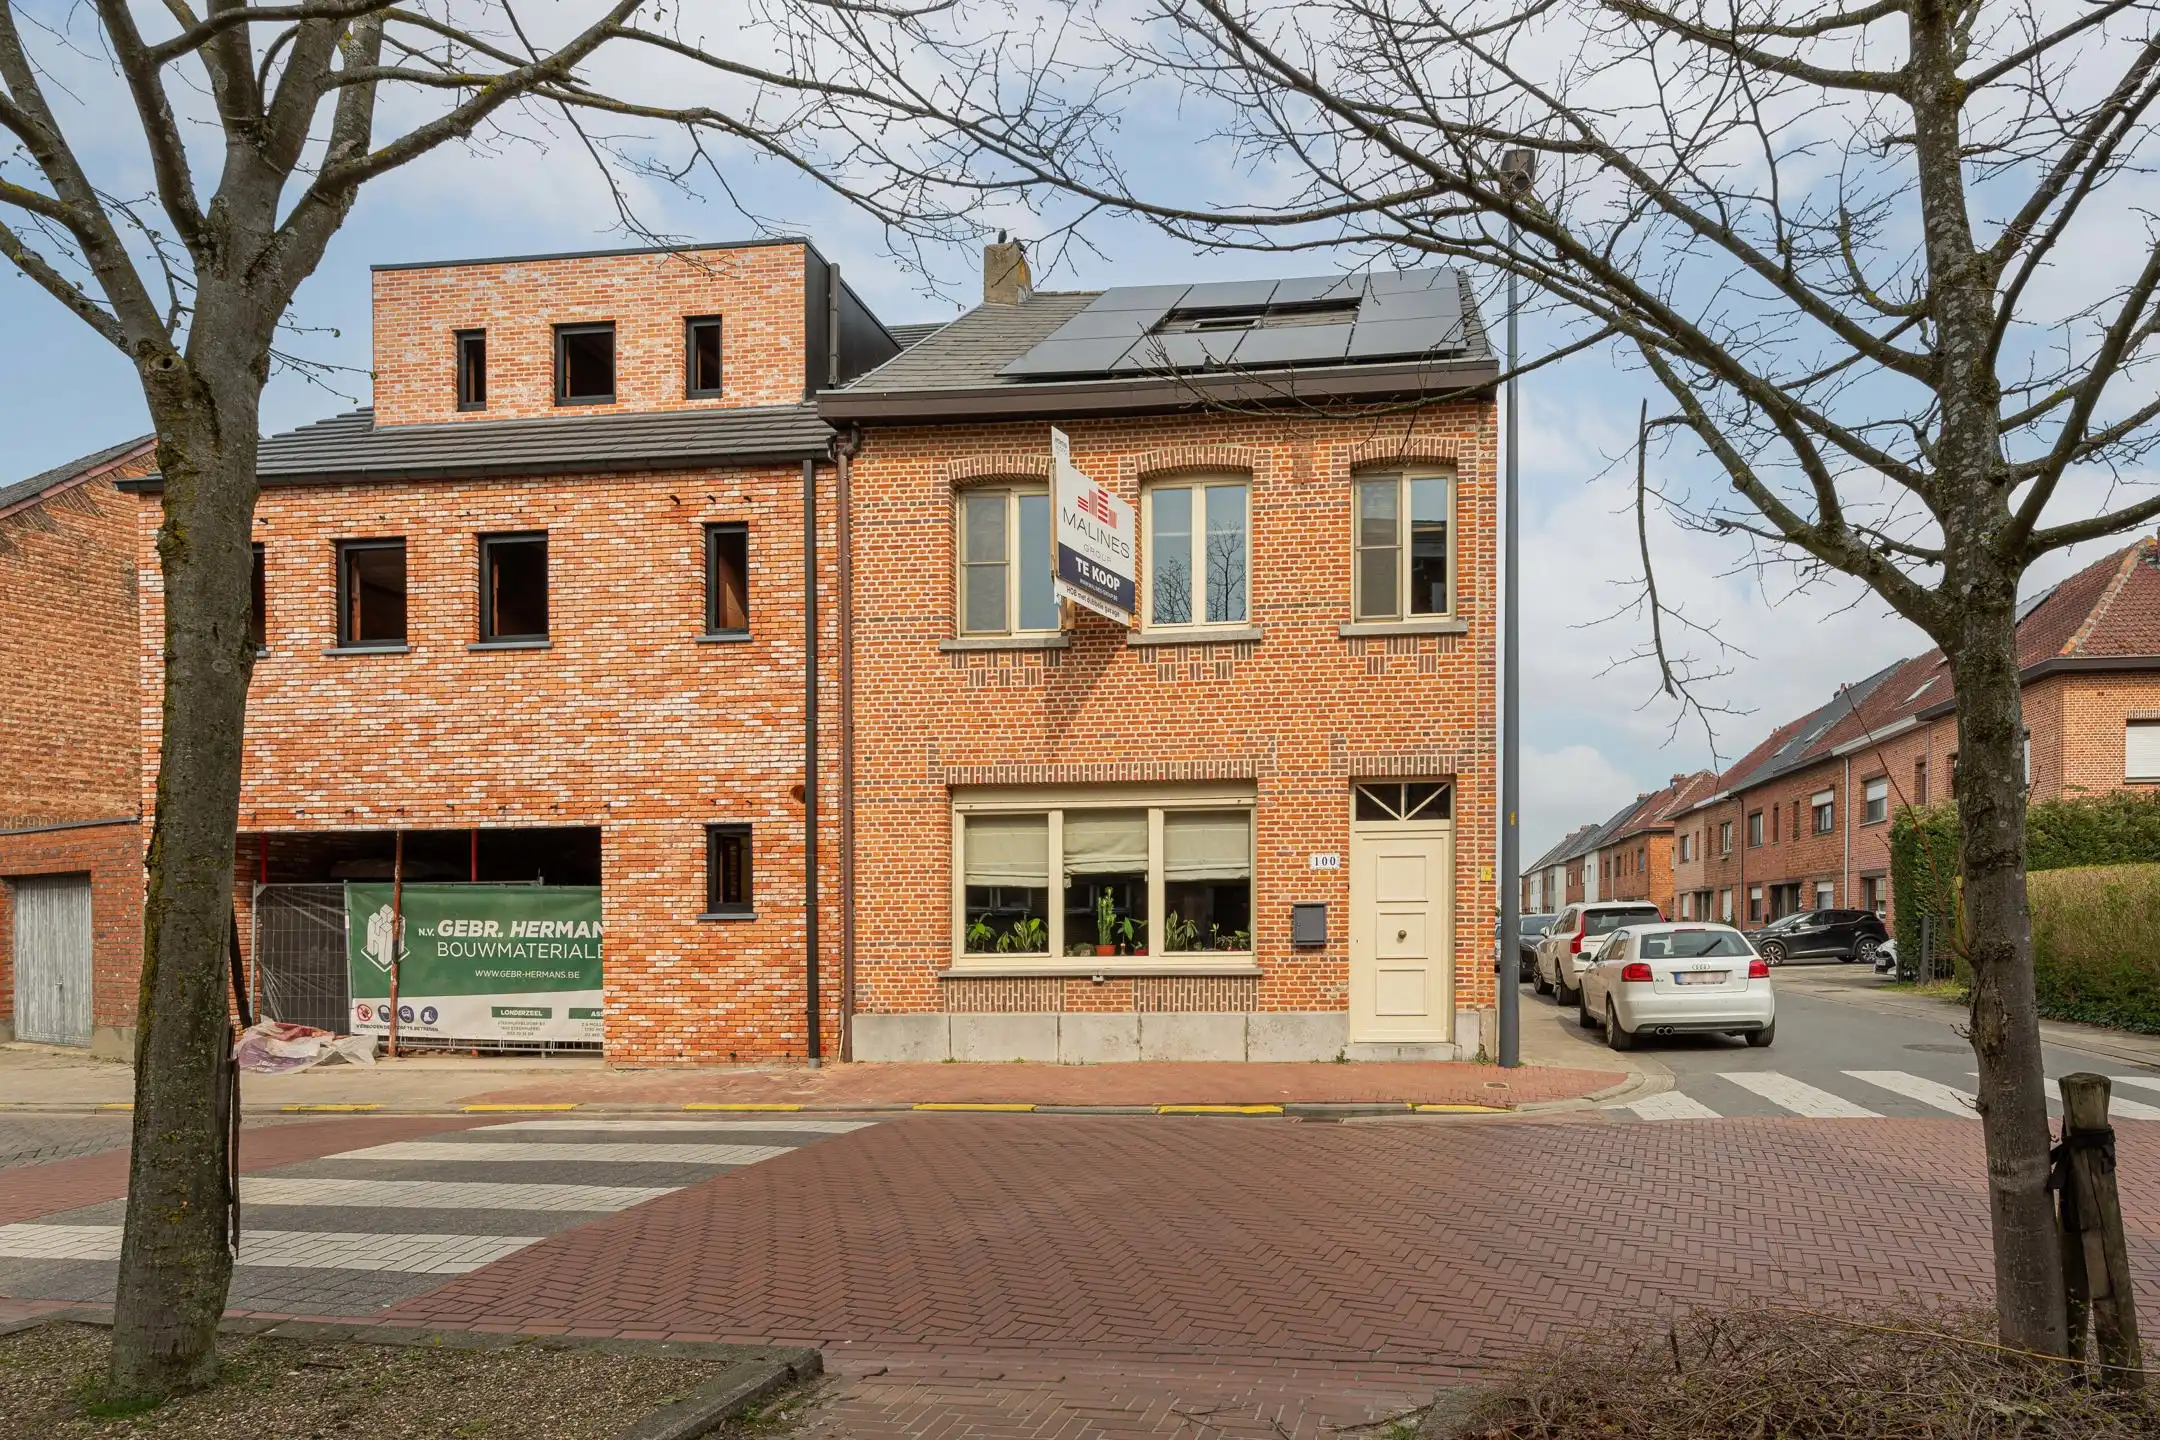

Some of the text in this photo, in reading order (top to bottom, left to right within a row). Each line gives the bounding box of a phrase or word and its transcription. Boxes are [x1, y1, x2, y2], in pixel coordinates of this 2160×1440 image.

[1063, 506, 1130, 559] MALINES
[1083, 543, 1112, 564] GROUP
[1075, 556, 1120, 591] TE KOOP
[1314, 856, 1336, 867] 100
[418, 919, 603, 939] N.V. GEBR. HERMAN
[437, 941, 603, 959] BOUWMATERIALE
[475, 969, 581, 979] WWW.GEBR-HERMANS.BE
[500, 1009, 543, 1017] LONDERZEEL
